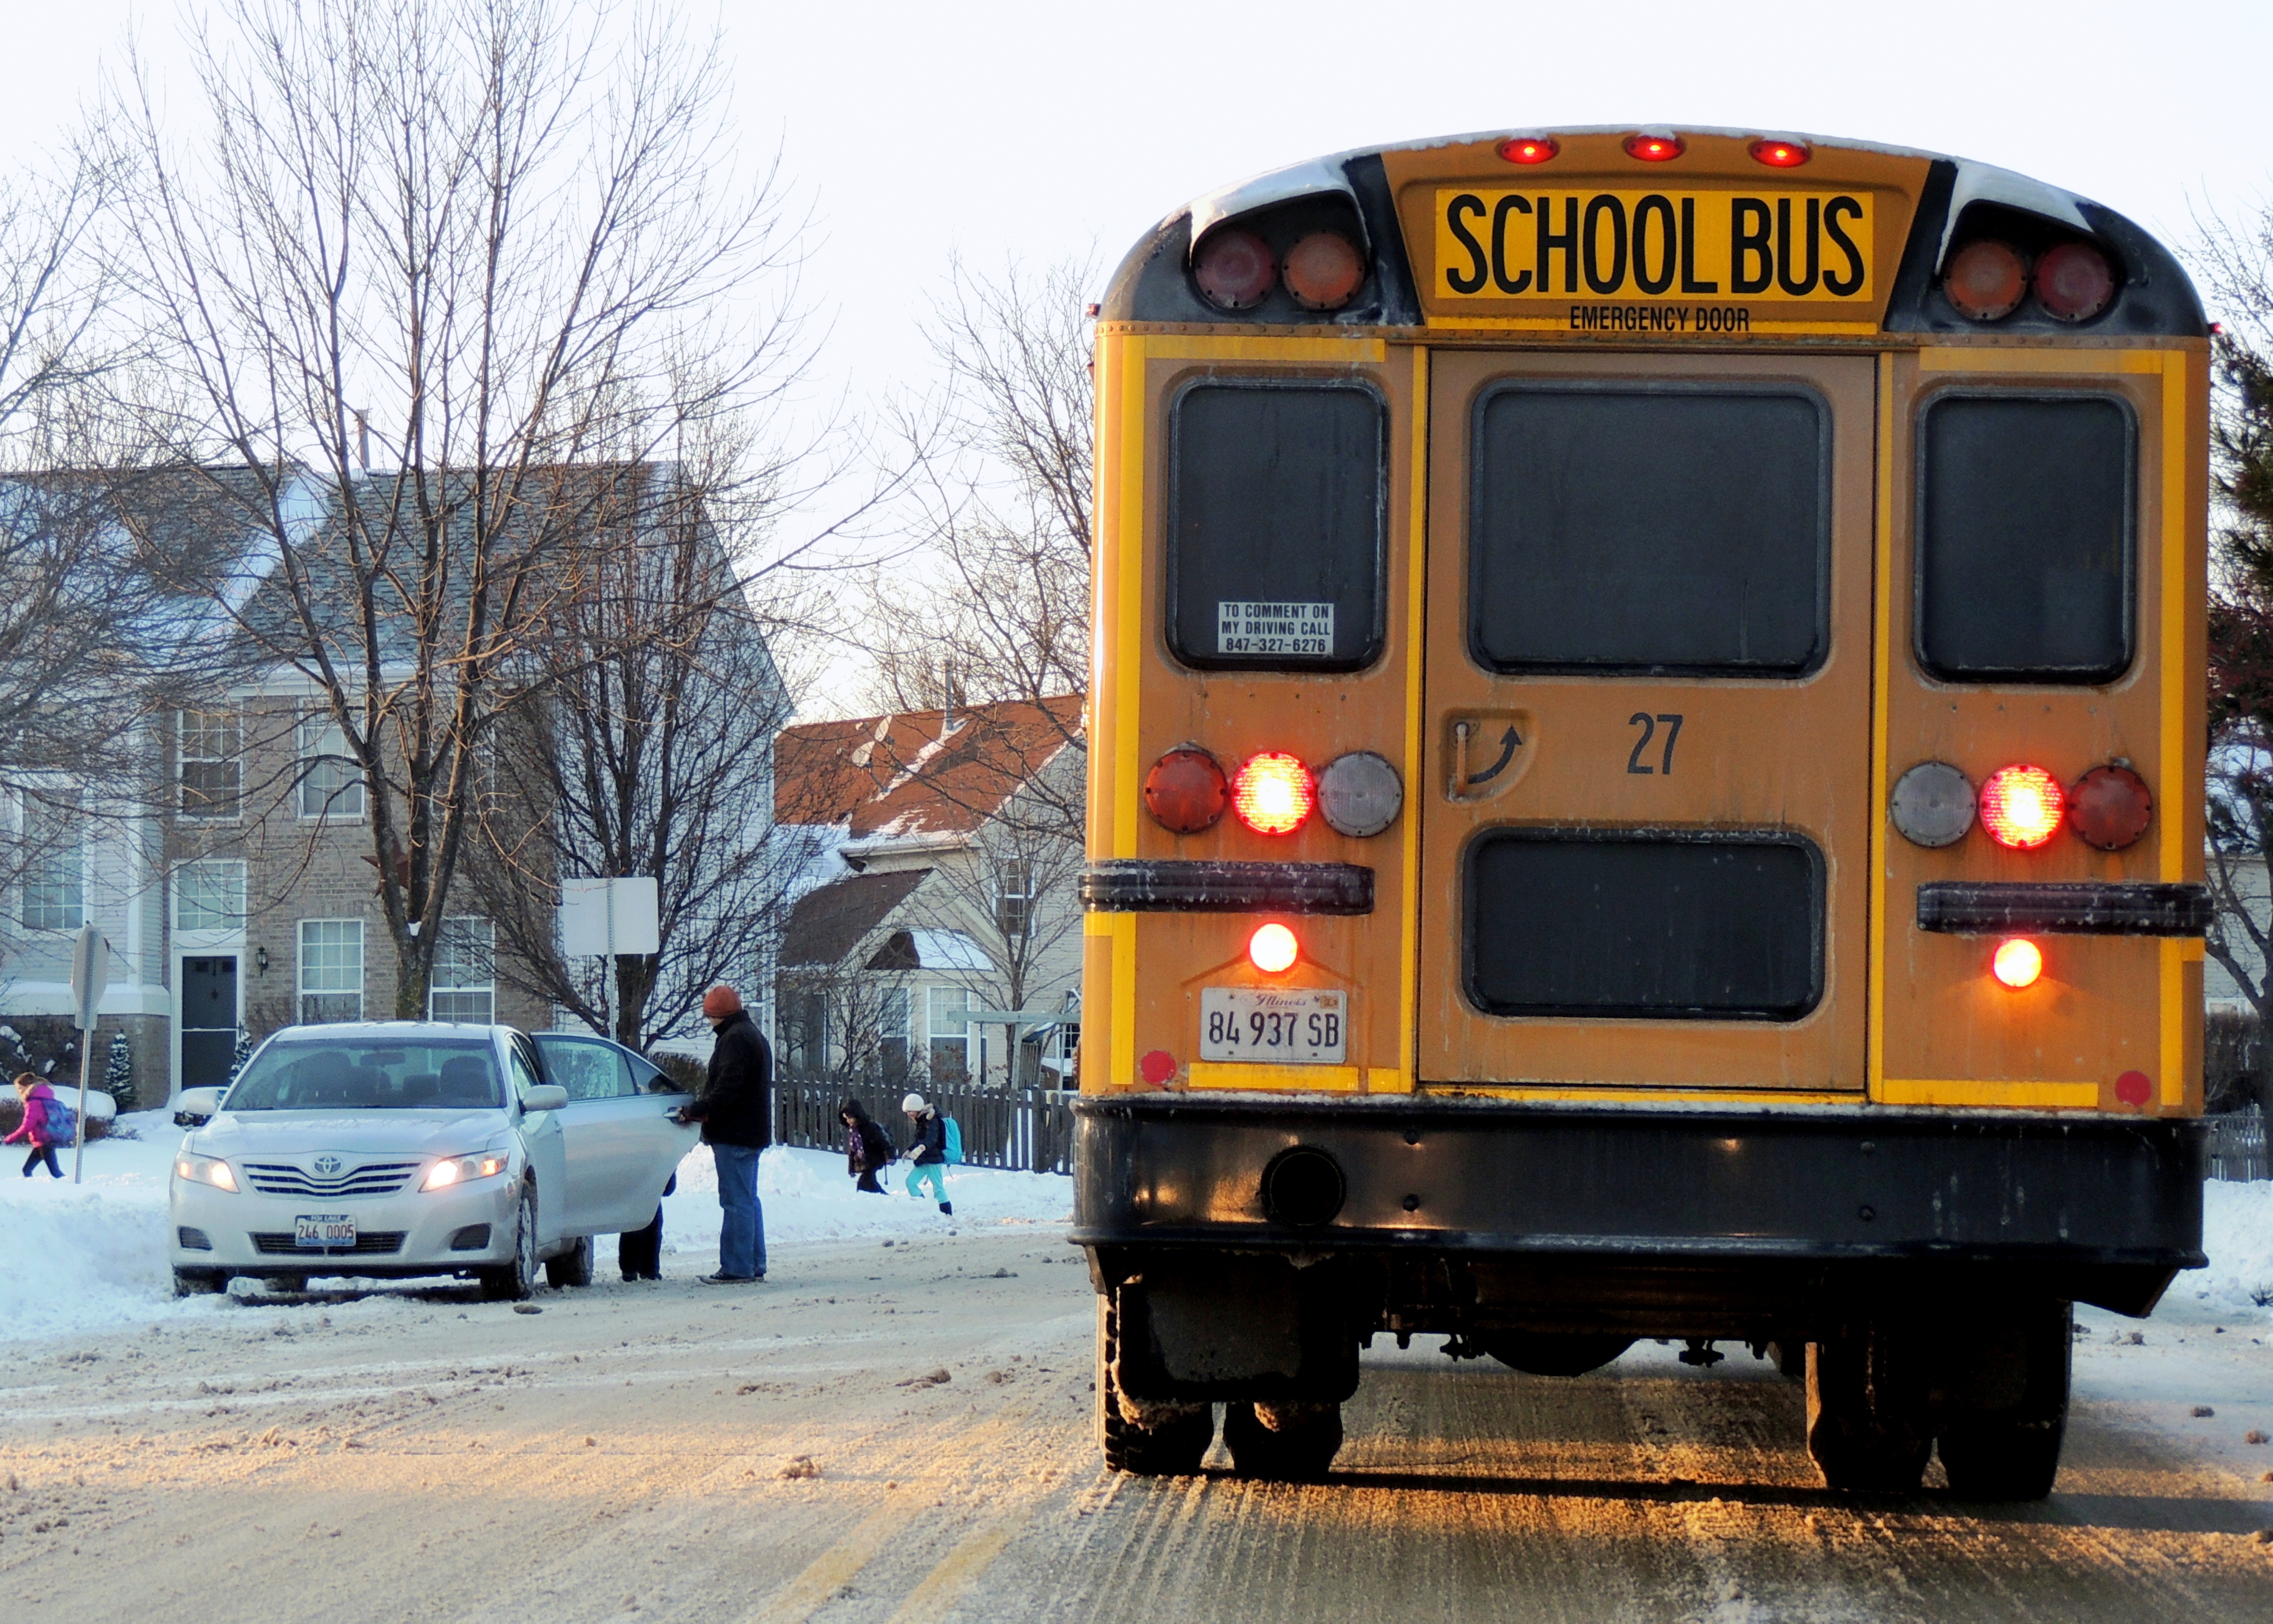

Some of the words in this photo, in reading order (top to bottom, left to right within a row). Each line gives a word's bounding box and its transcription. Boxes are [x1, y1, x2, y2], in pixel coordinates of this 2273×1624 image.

[1446, 194, 1718, 295] SCHOOL
[1732, 196, 1864, 296] BUS
[1570, 306, 1688, 331] EMERGENCY
[1696, 308, 1750, 332] DOOR
[1224, 604, 1239, 617] TO
[1245, 604, 1307, 618] COMMENT
[1312, 606, 1329, 618] ON
[1222, 621, 1239, 634] MY
[1245, 621, 1295, 635] DRIVING
[1301, 622, 1330, 635] CALL
[1226, 637, 1325, 652] 847-327-6276
[1627, 712, 1683, 774] 27
[1254, 995, 1306, 1006] Illinois
[1209, 1011, 1239, 1044] 84
[1250, 1011, 1298, 1046] 937
[1308, 1013, 1338, 1047] SB
[327, 1224, 354, 1239] 0005
